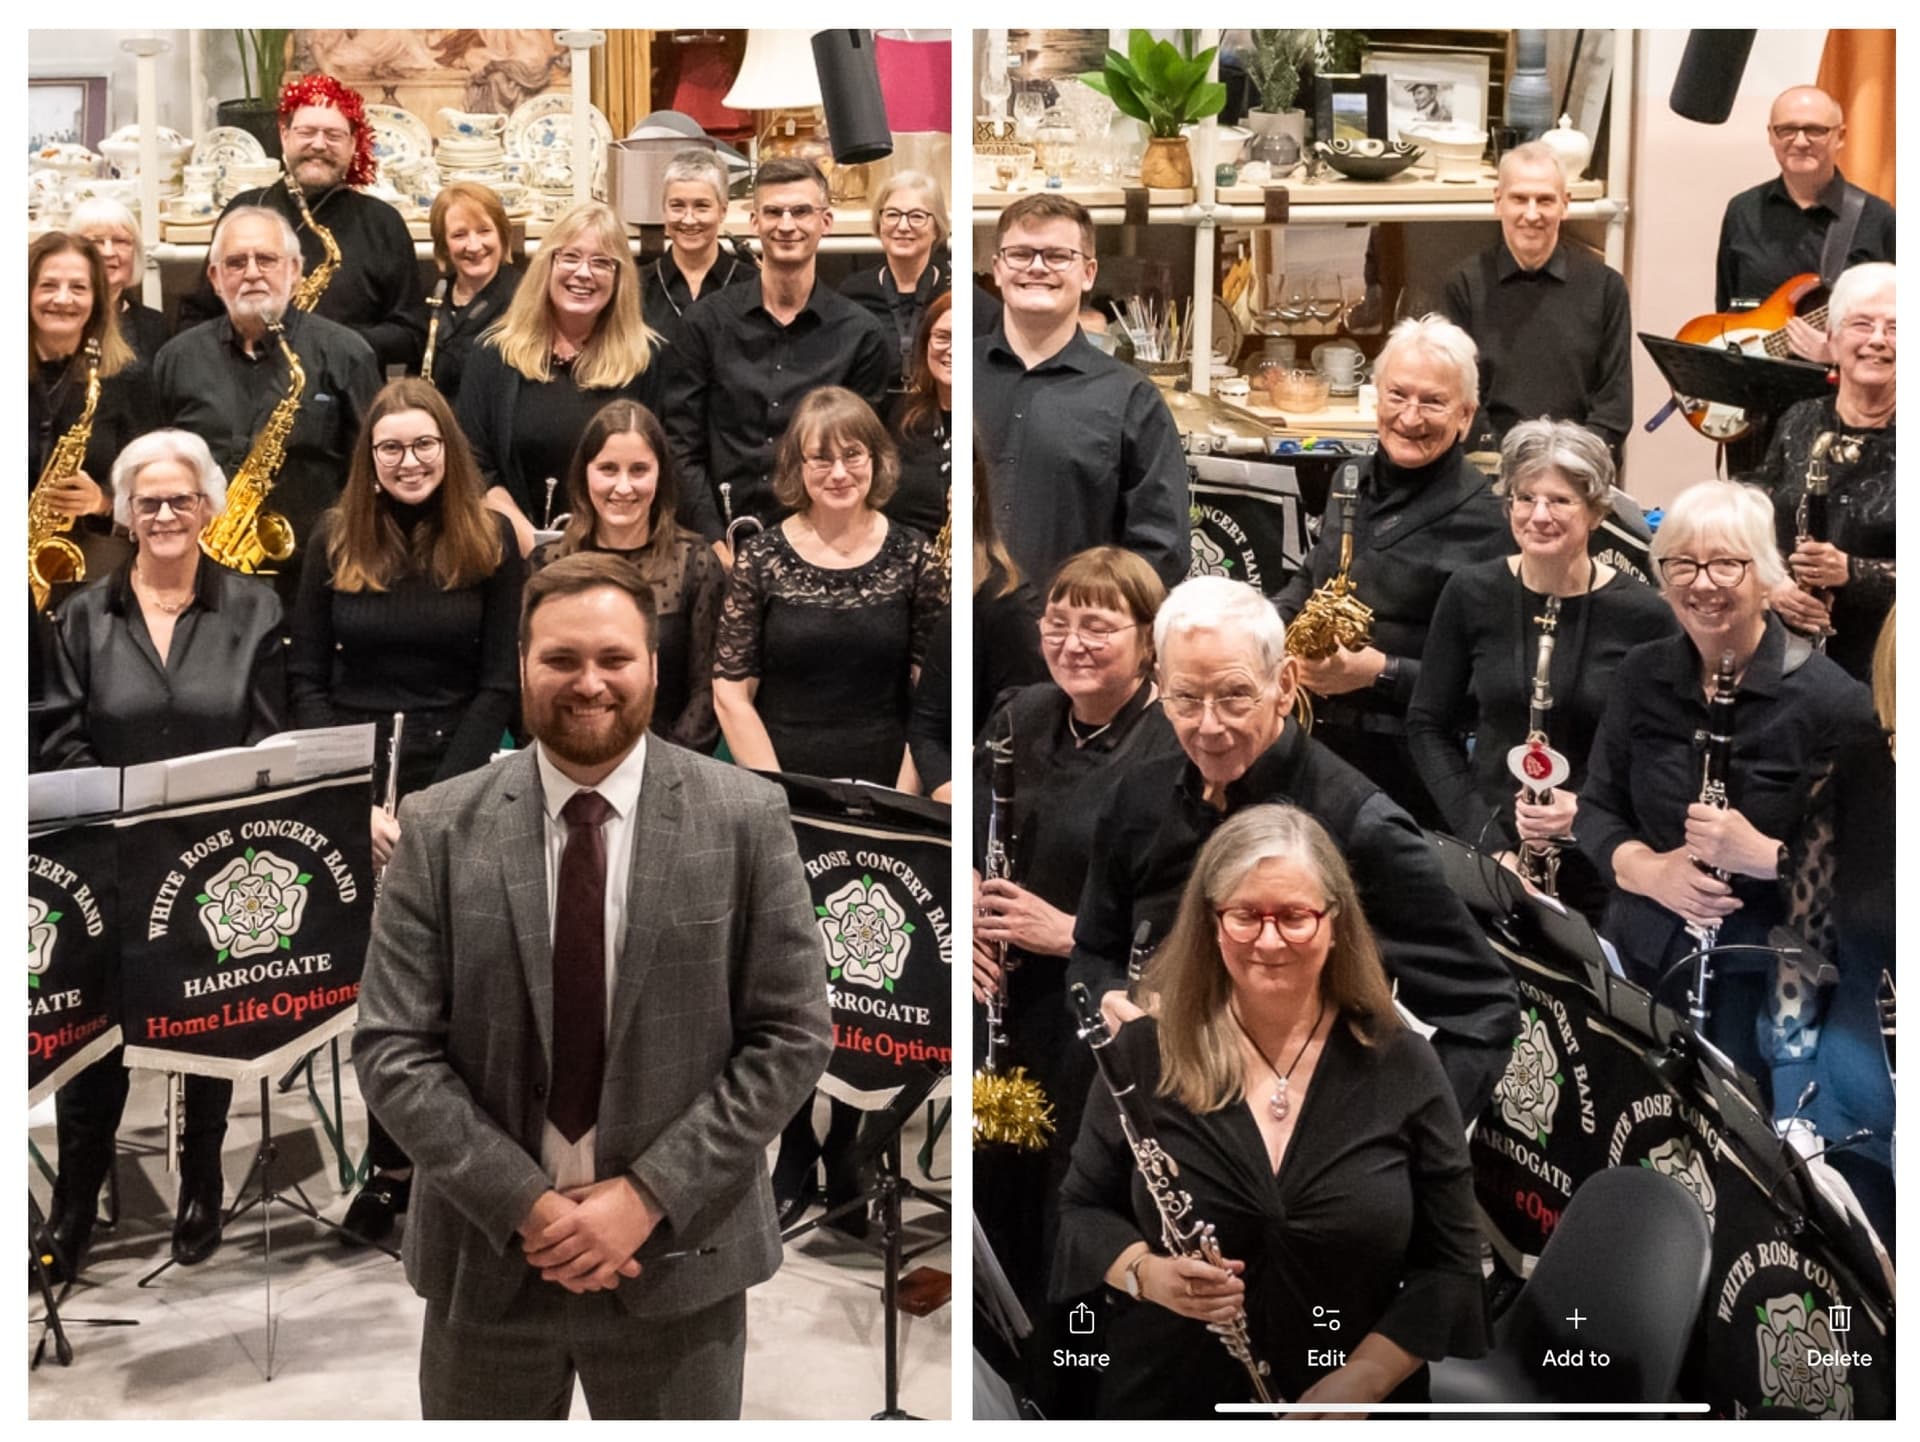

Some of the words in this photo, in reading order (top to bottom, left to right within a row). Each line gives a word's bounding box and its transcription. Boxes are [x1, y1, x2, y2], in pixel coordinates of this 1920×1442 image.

[1241, 548, 1262, 588] BAN
[148, 870, 186, 942] WHITE
[179, 829, 234, 869] ROSE
[241, 819, 328, 852] CONCERT
[323, 850, 358, 904] BAND
[805, 850, 851, 879] ROSE
[856, 851, 933, 905] CONCERT
[72, 883, 104, 937] BAND
[183, 953, 332, 998] HARROGATE
[147, 1013, 220, 1039] Home
[222, 997, 268, 1027] Life
[271, 982, 361, 1020] Options
[832, 1024, 873, 1053] Life
[1573, 1063, 1596, 1134] BAND
[1632, 1094, 1673, 1124] ROSE
[1717, 1251, 1755, 1324] WHITE
[1757, 1241, 1799, 1271] ROSE
